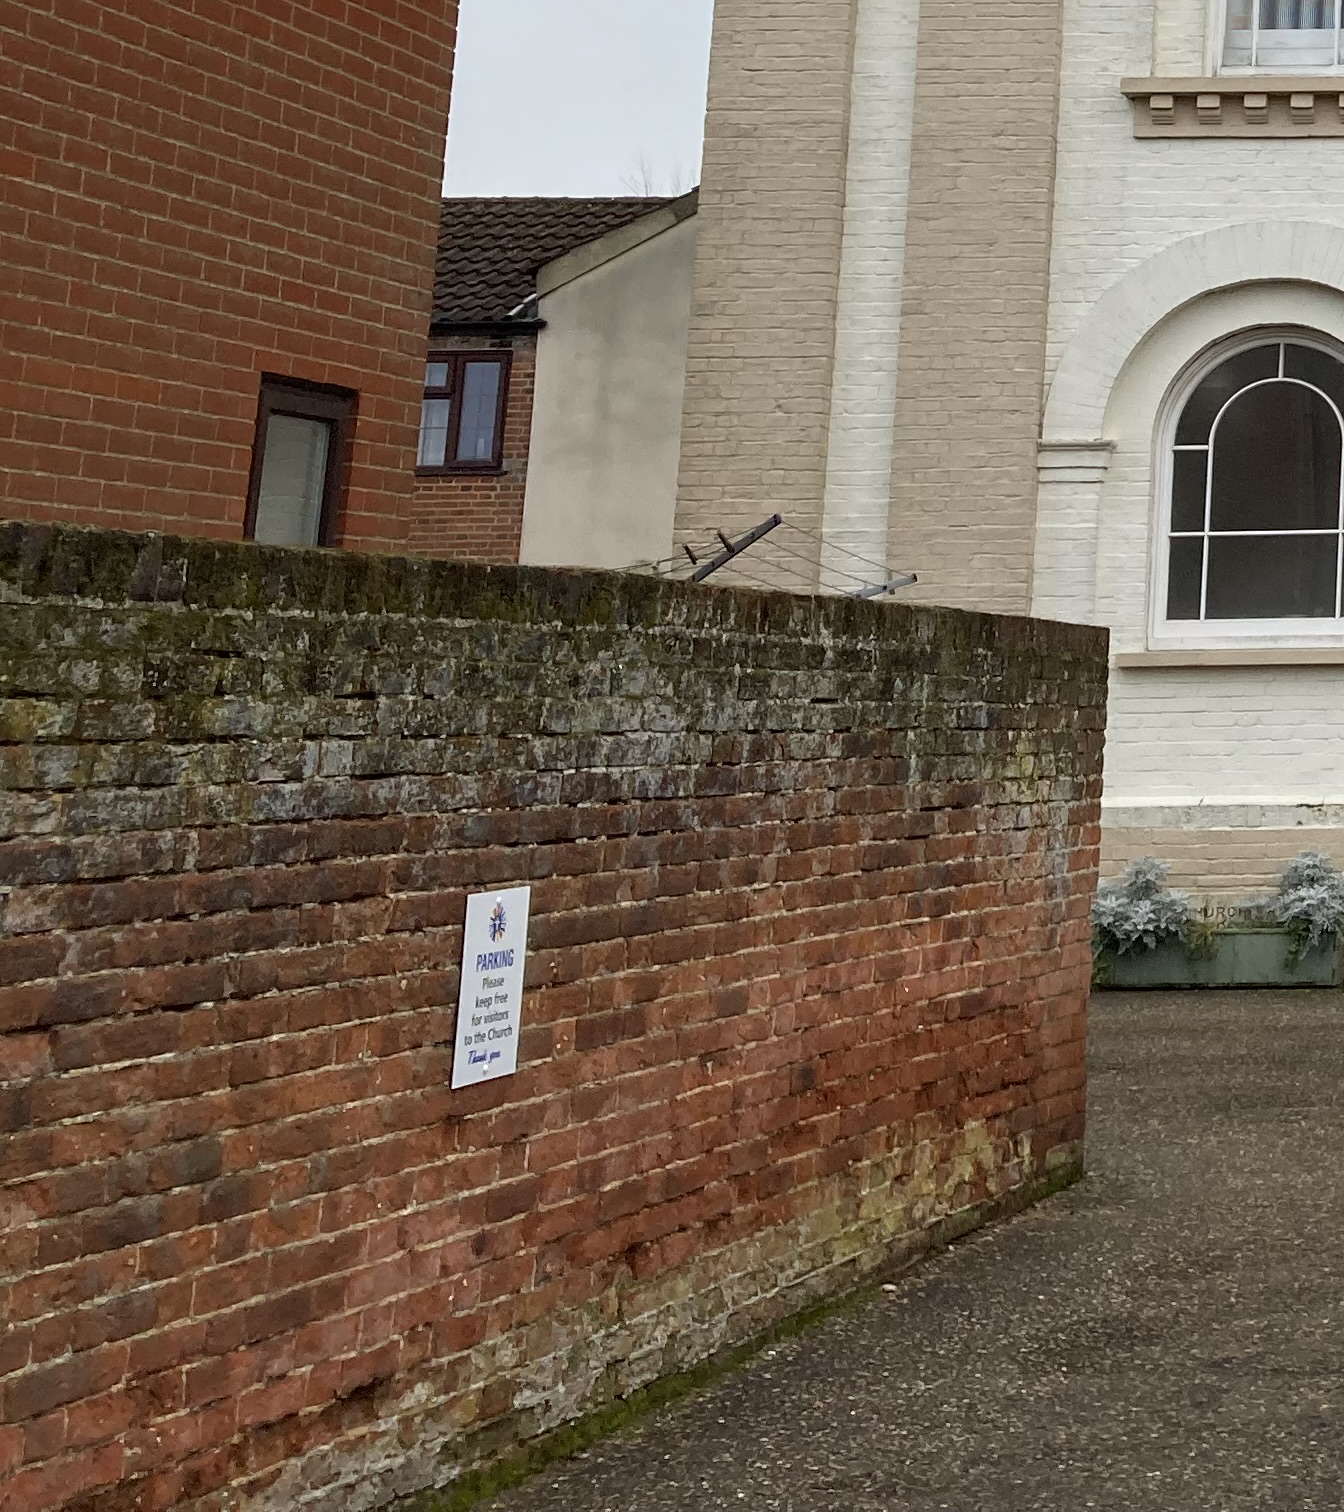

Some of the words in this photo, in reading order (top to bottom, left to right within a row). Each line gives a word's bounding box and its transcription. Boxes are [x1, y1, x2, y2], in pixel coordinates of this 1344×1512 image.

[476, 949, 514, 973] PARKING
[482, 977, 505, 990] Please
[475, 996, 492, 1009] keep
[494, 991, 508, 1004] free
[471, 1014, 482, 1027] for
[483, 1010, 509, 1024] visitors
[464, 1035, 473, 1046] to
[474, 1032, 486, 1044] the
[487, 1024, 512, 1041] Church
[468, 1049, 487, 1065] Thank
